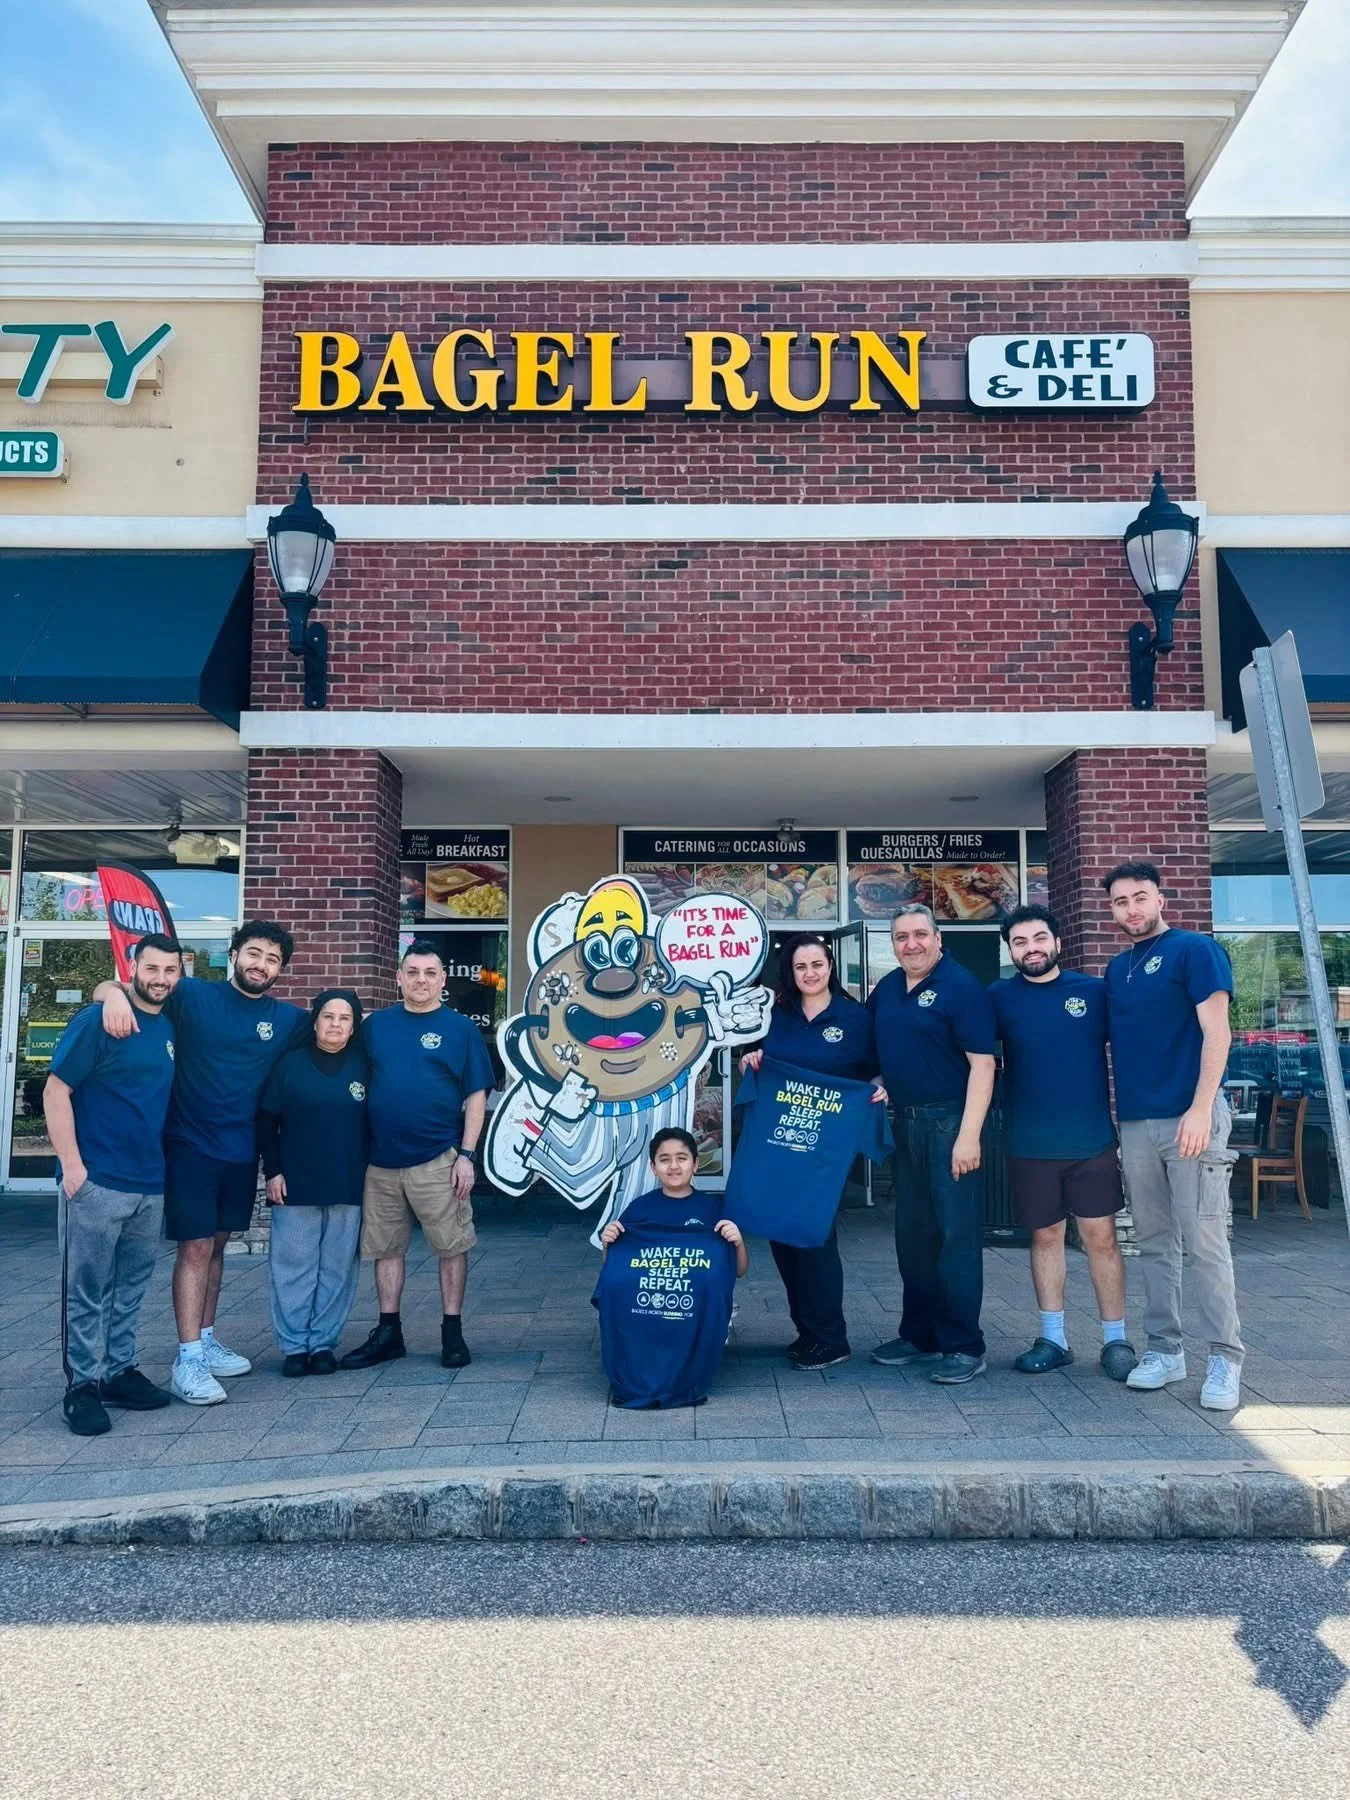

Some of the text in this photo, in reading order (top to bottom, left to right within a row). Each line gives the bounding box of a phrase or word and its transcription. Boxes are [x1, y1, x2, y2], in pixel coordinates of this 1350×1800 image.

[292, 328, 928, 414] BAGEL RUN
[987, 375, 1137, 401] & DELI
[463, 834, 481, 843] Hot
[882, 835, 939, 847] BURGERS
[949, 834, 983, 847] FRIES
[436, 845, 507, 857] BREAKFAST
[654, 840, 716, 853] CATERING
[733, 840, 807, 853] OCCASIONS
[860, 847, 944, 860] QUESADILLAS
[946, 850, 969, 860] Made
[971, 851, 978, 860] to
[66, 888, 105, 911] OPE
[712, 907, 749, 921] TIME
[687, 923, 736, 938] FOR A
[668, 943, 715, 962] BAGEL
[31, 1041, 56, 1049] LUCKY
[785, 1080, 841, 1102] WAKE UP
[776, 1090, 843, 1114] BAGEL RUN
[789, 1105, 822, 1120] SLEEP
[779, 1115, 822, 1132] REPEAT.
[640, 1247, 704, 1258] WAKE UP
[630, 1257, 711, 1269] BAGEL RUN
[648, 1267, 689, 1278] SLEEP
[639, 1277, 694, 1292] REPEAT.
